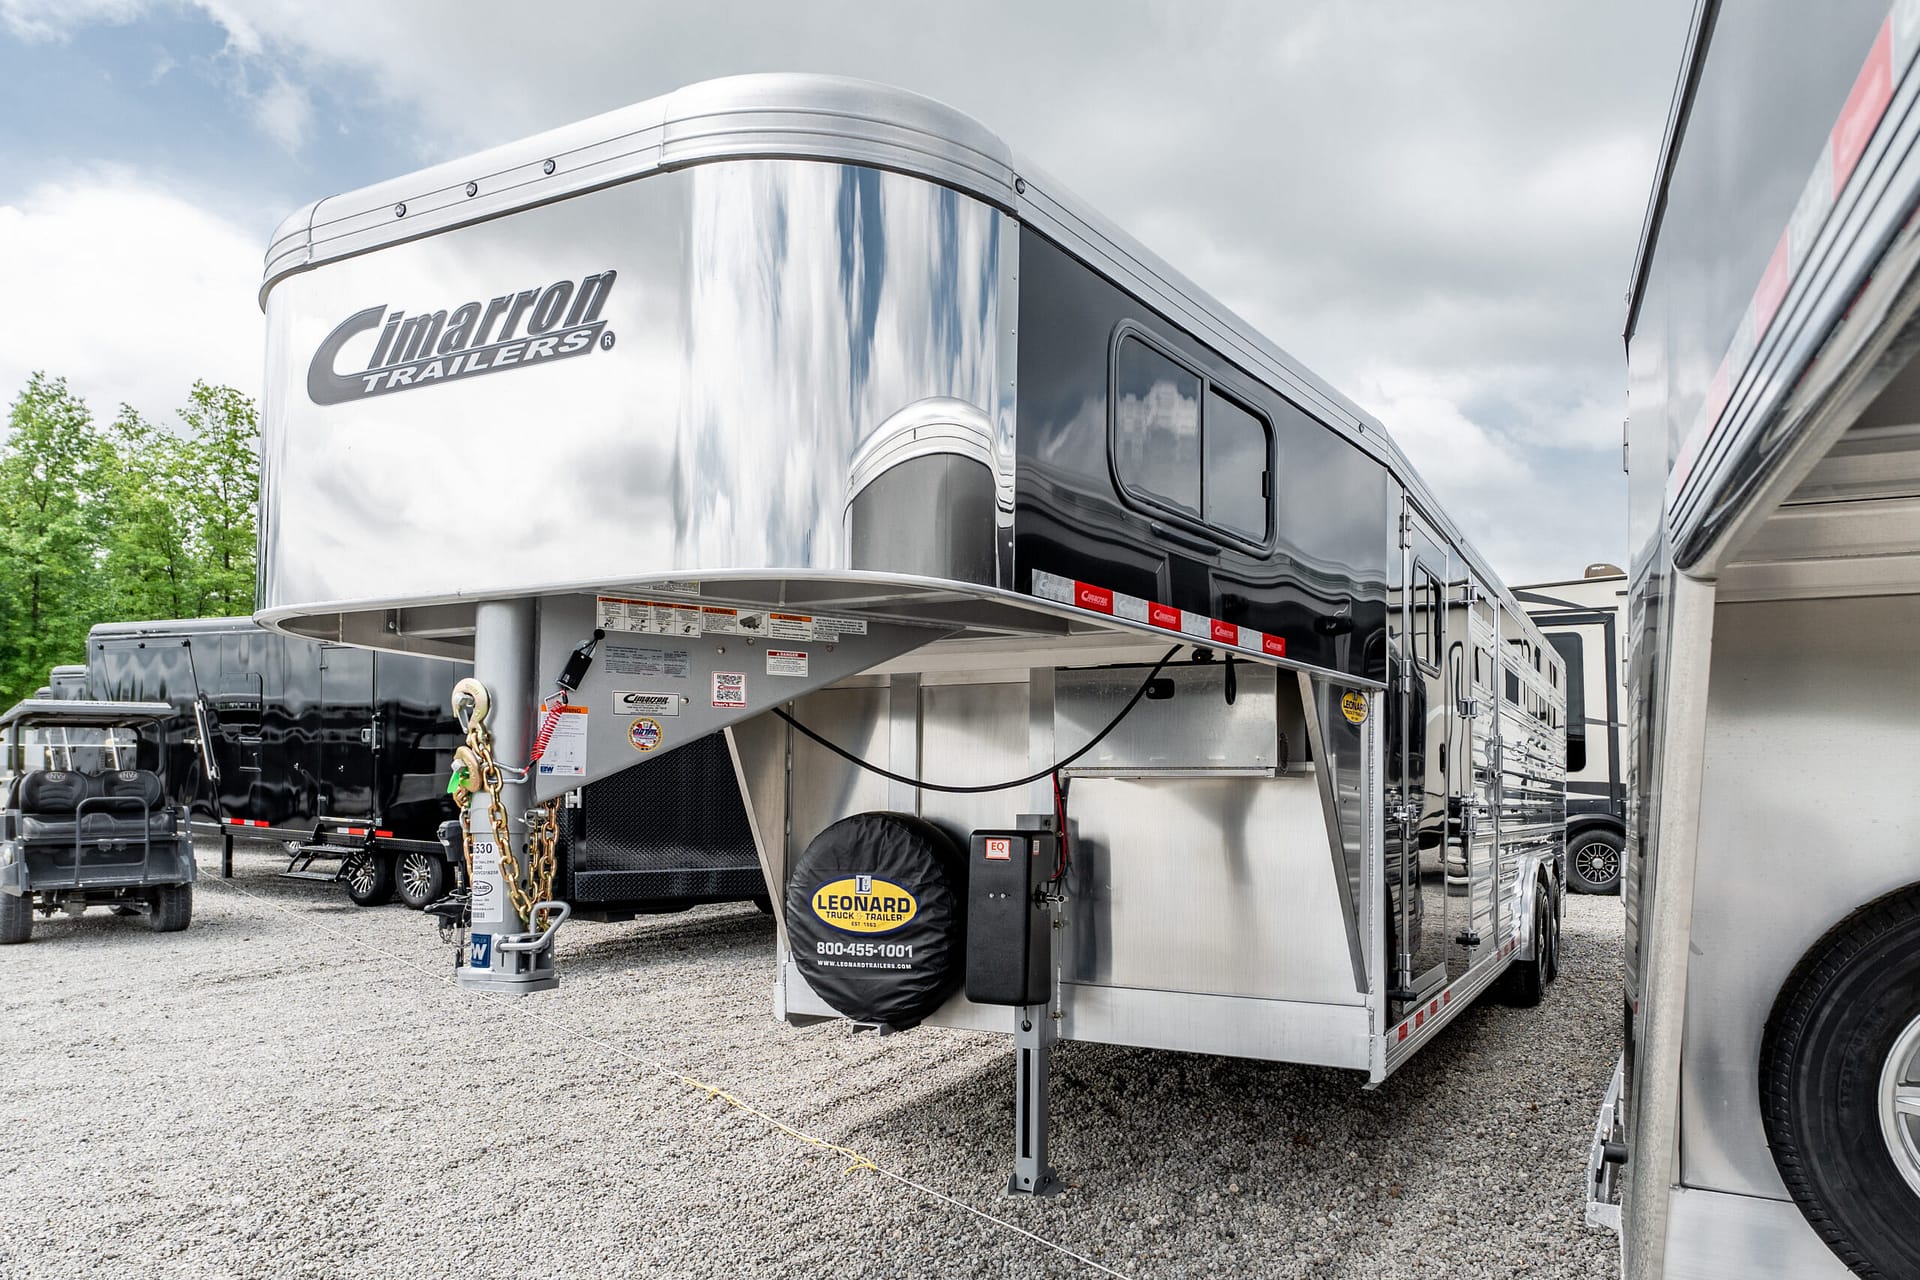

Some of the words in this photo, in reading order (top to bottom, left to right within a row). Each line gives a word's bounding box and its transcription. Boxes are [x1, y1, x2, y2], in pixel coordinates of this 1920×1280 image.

[307, 270, 617, 405] Cimarron
[362, 329, 592, 393] TRAILERS
[991, 842, 1005, 853] EQ
[817, 894, 911, 914] LEONARD
[826, 911, 855, 920] TRUCK
[865, 912, 903, 922] TRAILER
[816, 941, 913, 959] 800-455-1001
[817, 959, 913, 970] WWW.LEONARDTRAILERS.COM
